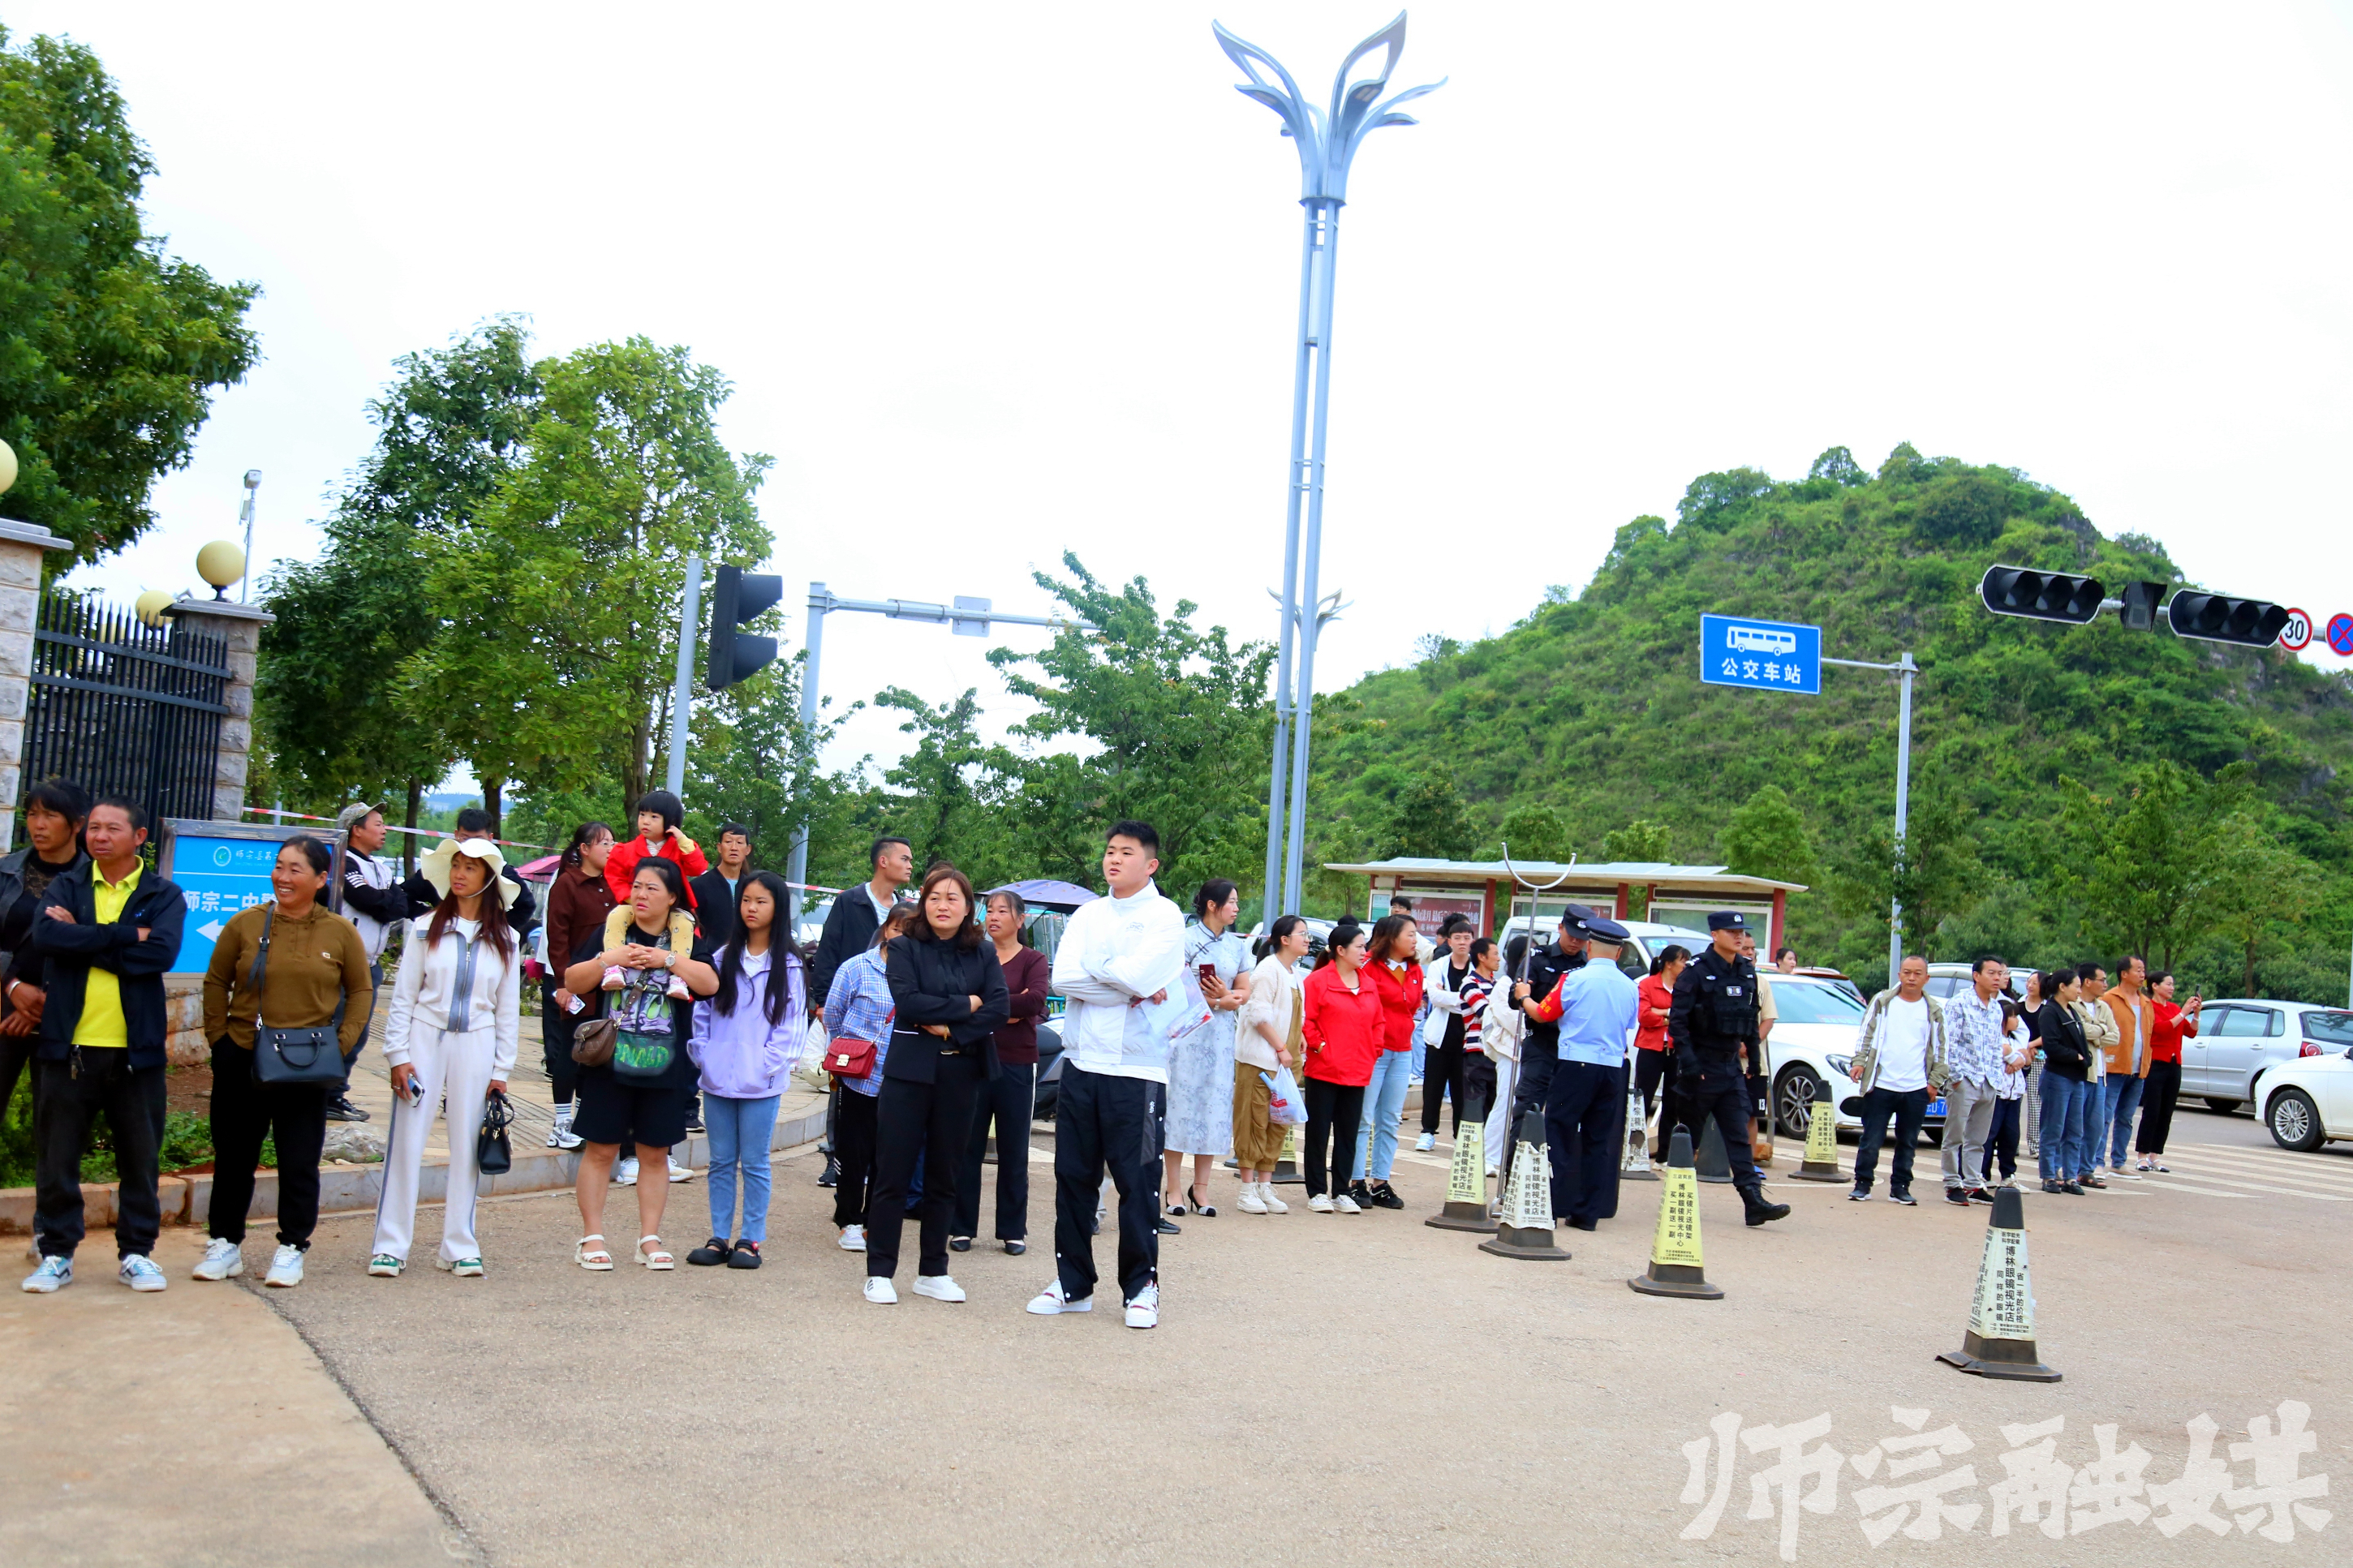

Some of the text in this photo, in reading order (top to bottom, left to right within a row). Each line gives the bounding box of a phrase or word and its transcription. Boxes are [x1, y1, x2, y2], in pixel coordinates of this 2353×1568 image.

[2285, 619, 2304, 641] 30
[1721, 657, 1801, 685] 公交车站
[1668, 1191, 1677, 1239] 买一副送一副
[1676, 1184, 1685, 1247] 博林眼镜视光中心
[1685, 1192, 1693, 1239] 买镜片送镜架
[1996, 1270, 2004, 1321] 同样的眼镜
[2004, 1245, 2016, 1323] 博林眼镜视光店
[2015, 1272, 2024, 1323] 省一半的价格
